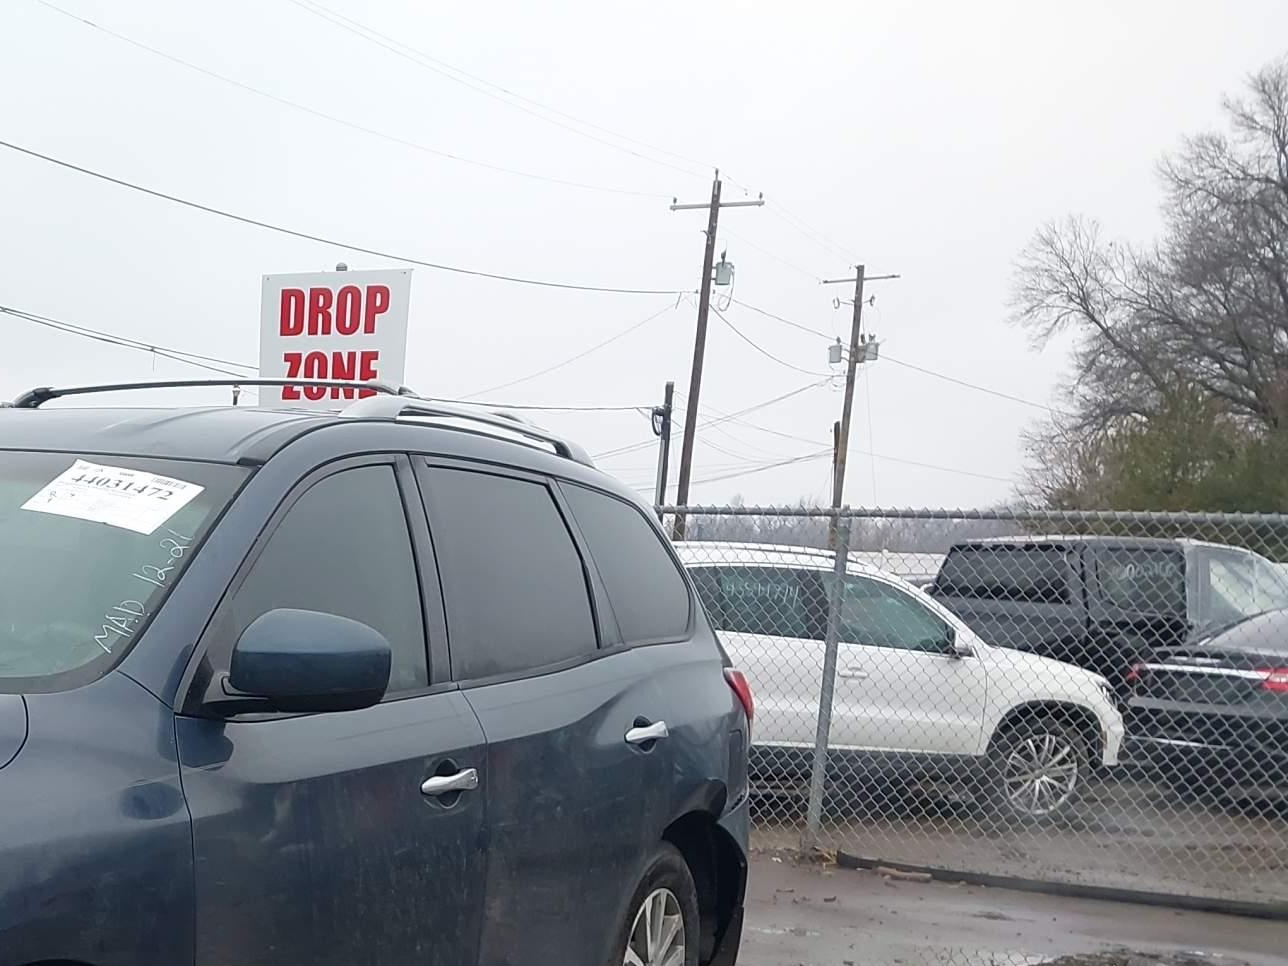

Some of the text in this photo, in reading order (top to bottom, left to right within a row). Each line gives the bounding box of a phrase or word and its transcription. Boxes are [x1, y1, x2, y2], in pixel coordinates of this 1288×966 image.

[278, 284, 391, 337] DROP
[281, 350, 380, 401] ZONE
[71, 473, 174, 501] 44031472
